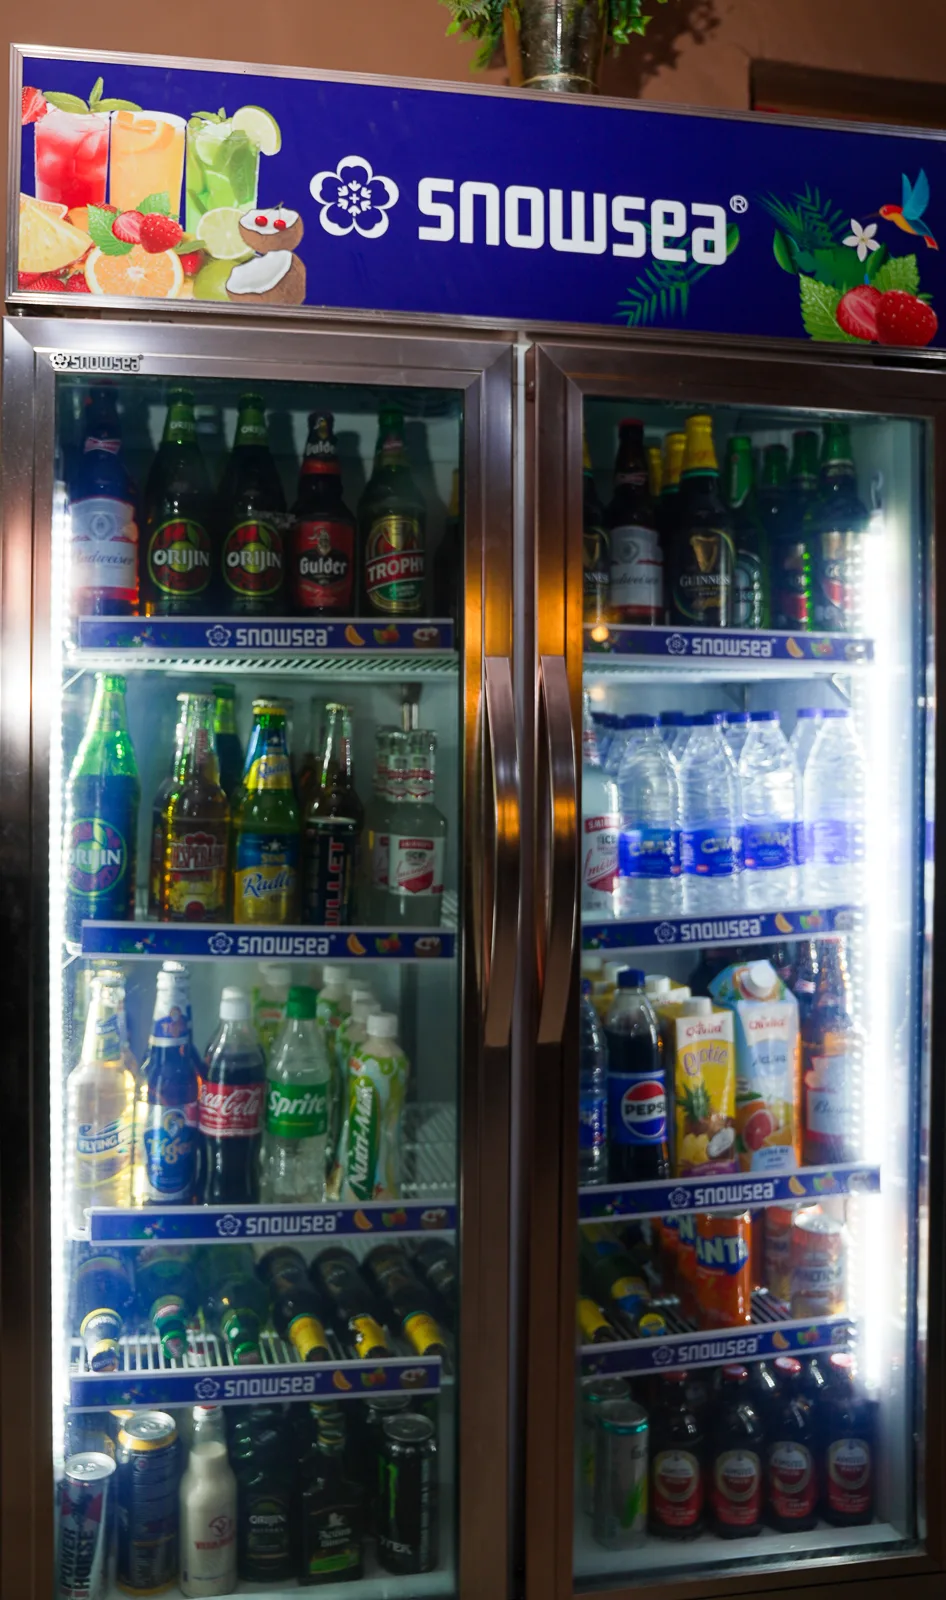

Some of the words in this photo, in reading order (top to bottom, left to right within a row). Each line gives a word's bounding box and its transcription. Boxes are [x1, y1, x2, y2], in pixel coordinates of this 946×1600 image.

[170, 420, 195, 432] ORIJ
[153, 549, 210, 570] ORIJIN
[226, 551, 282, 571] ORIJIN
[300, 557, 348, 575] Gulder
[679, 573, 731, 587] GUINNESS
[324, 841, 345, 926] ULLET
[267, 1090, 329, 1118] Sprite
